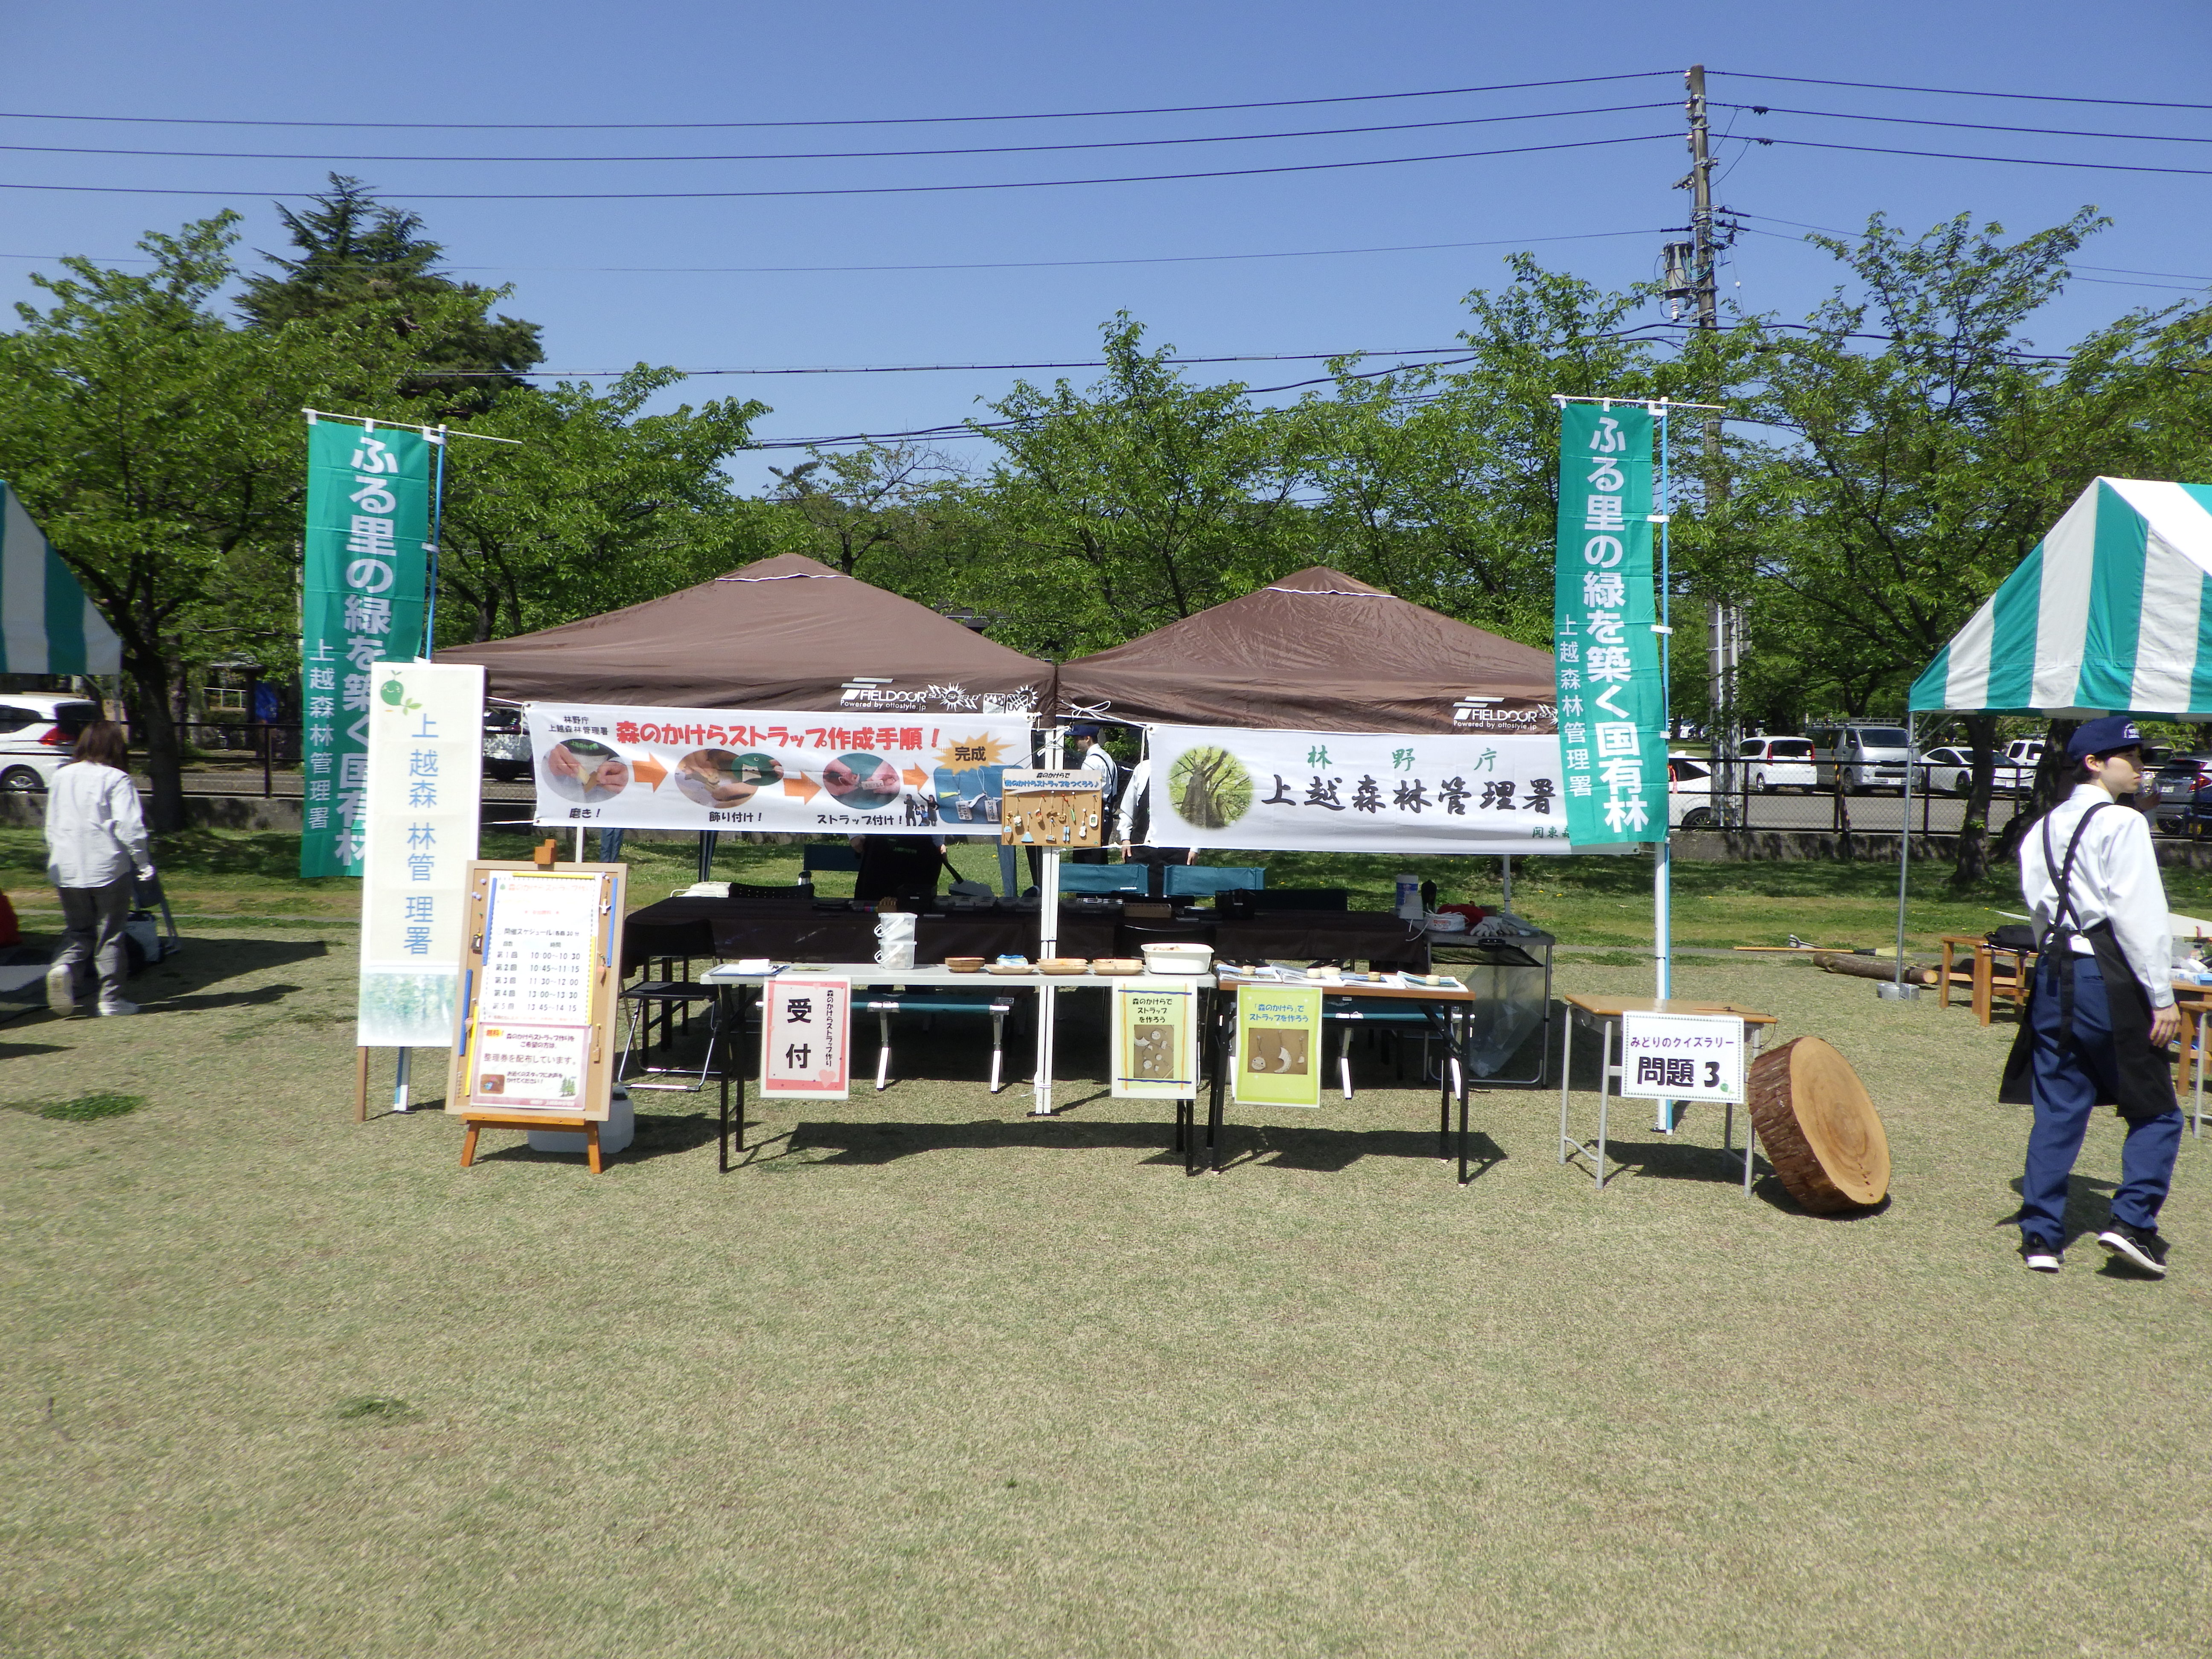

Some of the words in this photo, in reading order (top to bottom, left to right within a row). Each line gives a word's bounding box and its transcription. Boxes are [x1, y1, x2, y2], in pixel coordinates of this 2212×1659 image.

[1584, 416, 1650, 833] ふる里の緑を築く国有林
[860, 690, 927, 703] FIELDOOR
[840, 699, 872, 708] Powered
[873, 700, 883, 710] by
[885, 701, 926, 712] ottostyle.jp
[1560, 614, 1593, 798] 上越森林管理署
[563, 715, 589, 725] 林野庁
[1472, 709, 1537, 722] FIELDOOR
[548, 725, 608, 735] 上越森林管理署
[1487, 721, 1496, 729] by
[1498, 721, 1537, 731] ottostyle.jp
[308, 638, 335, 829] 上越森林管理署
[615, 720, 940, 751] 森のかけらストラップ作成手順！
[955, 746, 986, 762] 完成
[1261, 774, 1556, 815] 上越森林管理署
[404, 713, 439, 955] 上越森林管理署
[1249, 1013, 1309, 1023] ストラップを作ろう
[786, 998, 812, 1069] 受付
[1630, 1036, 1734, 1048] みどりのクイズラリー
